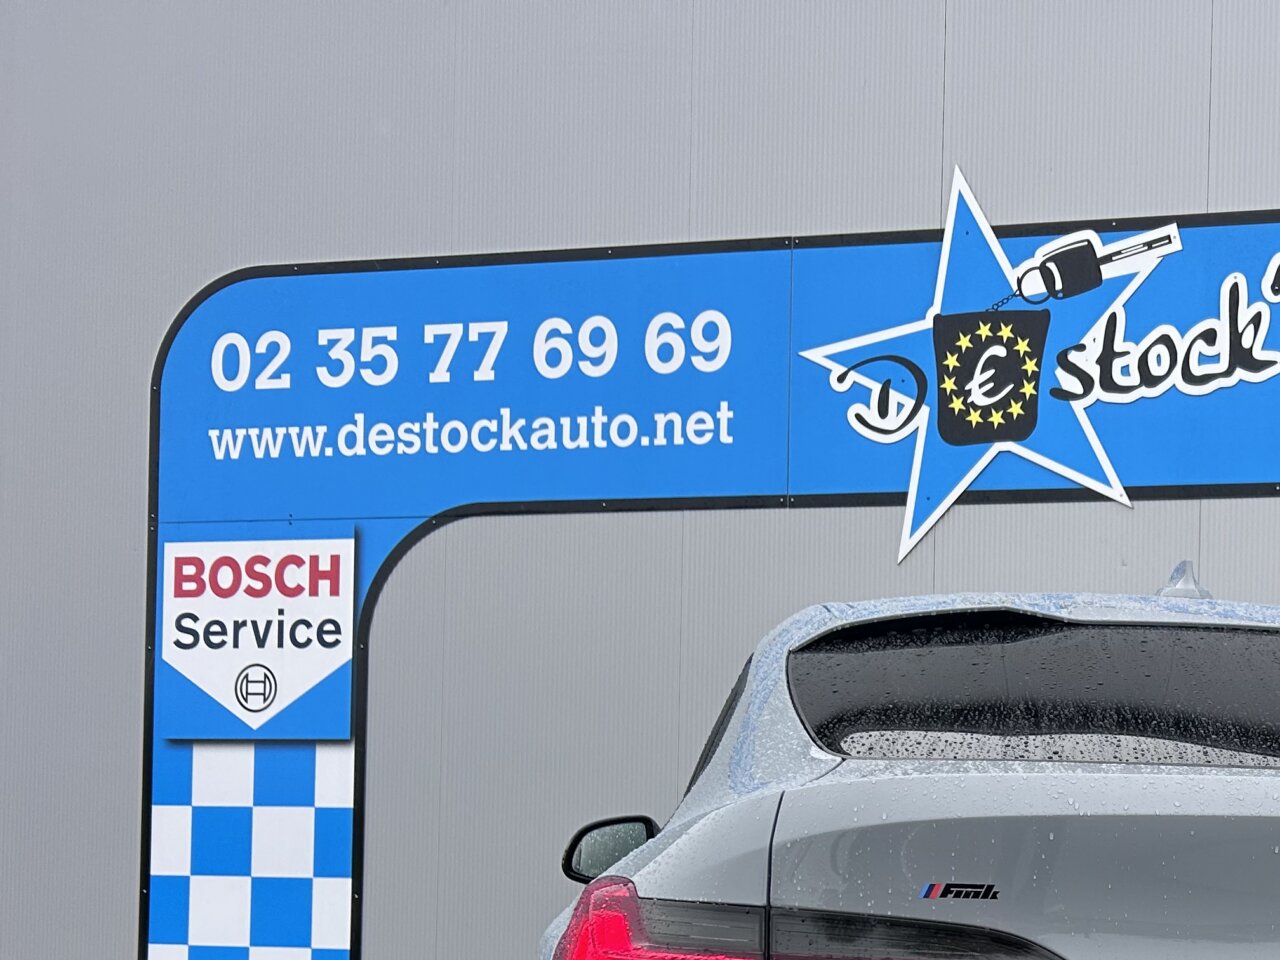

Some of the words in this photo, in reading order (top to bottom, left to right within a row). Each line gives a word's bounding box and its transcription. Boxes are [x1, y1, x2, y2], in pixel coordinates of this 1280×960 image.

[211, 331, 291, 392] 02
[316, 326, 398, 388] 35
[423, 320, 509, 383] 77
[533, 315, 618, 380] 69
[644, 310, 732, 374] 69
[209, 401, 734, 461] www.destockauto.net
[173, 554, 341, 599] BOSCH
[173, 608, 342, 651] Service
